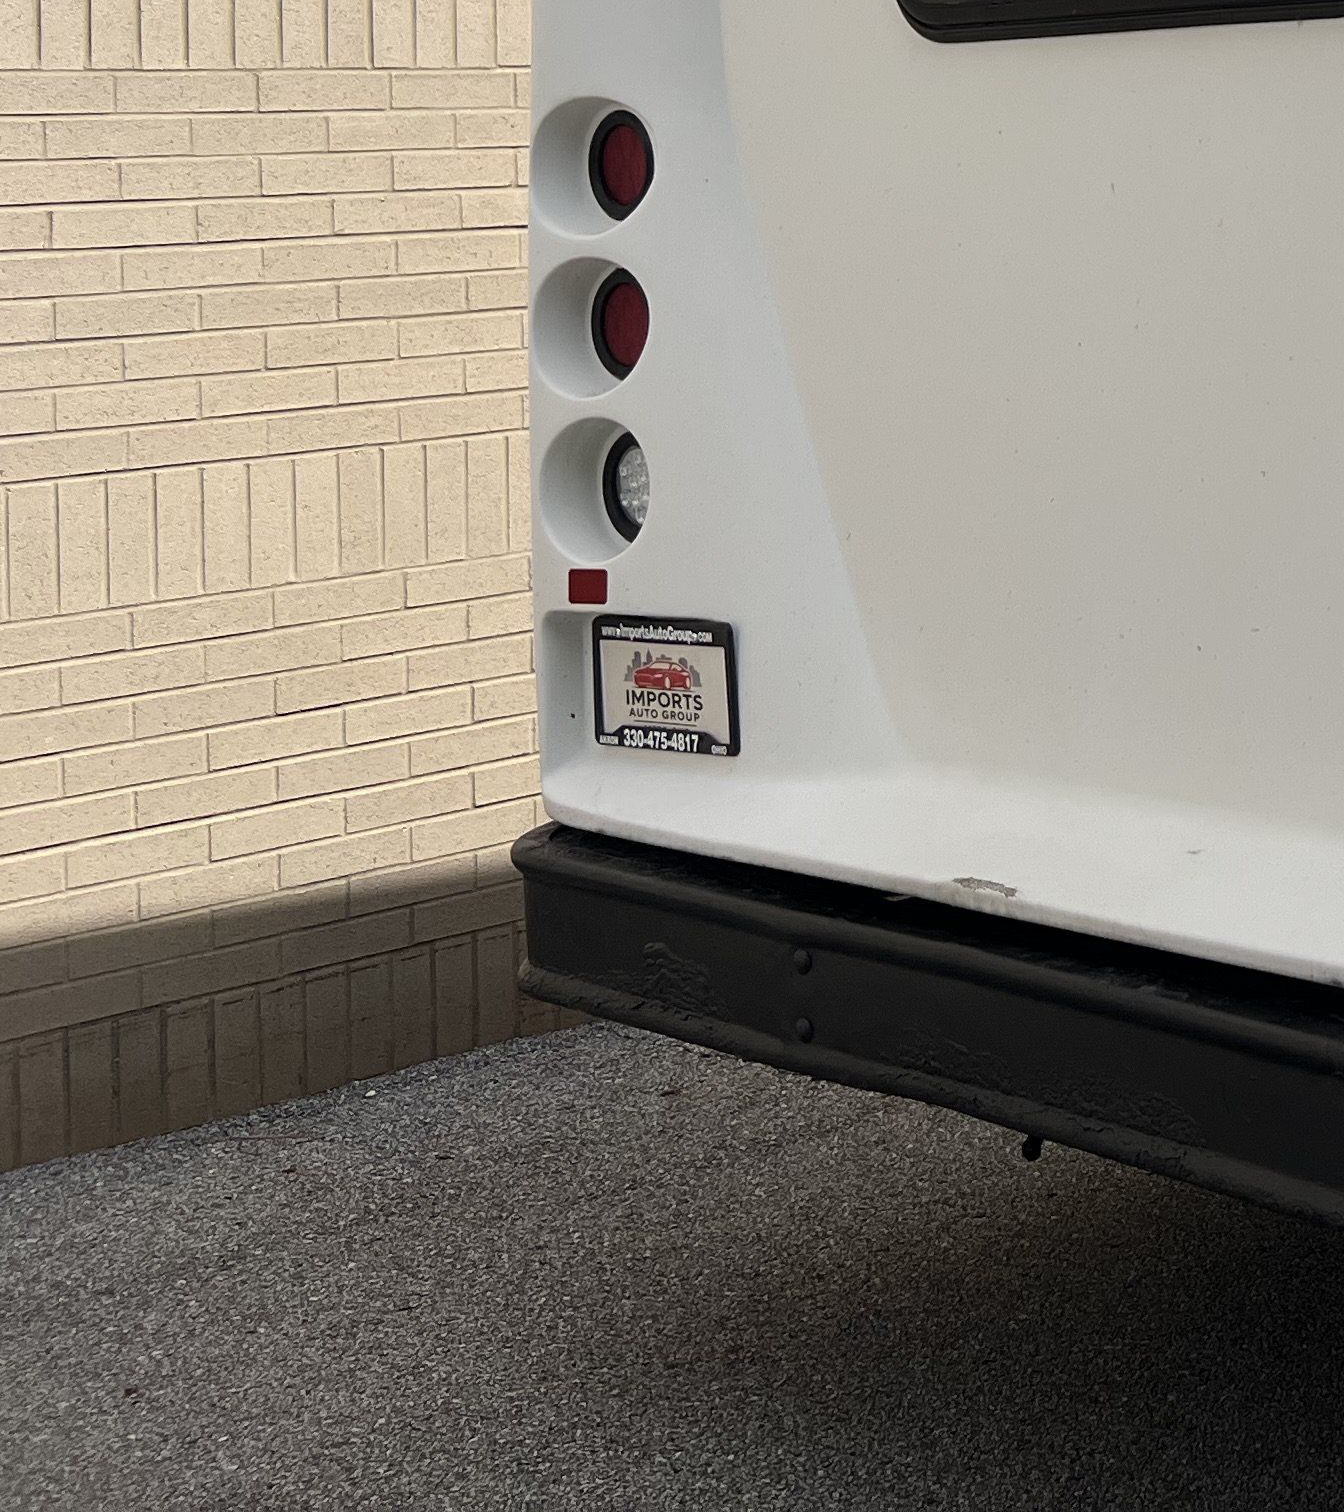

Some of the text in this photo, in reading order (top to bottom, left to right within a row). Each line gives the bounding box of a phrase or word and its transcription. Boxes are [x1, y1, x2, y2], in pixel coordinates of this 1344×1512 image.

[626, 689, 703, 711] IMPORTS
[629, 708, 700, 723] AUTO GROUP
[623, 728, 699, 753] 330-475-4817
